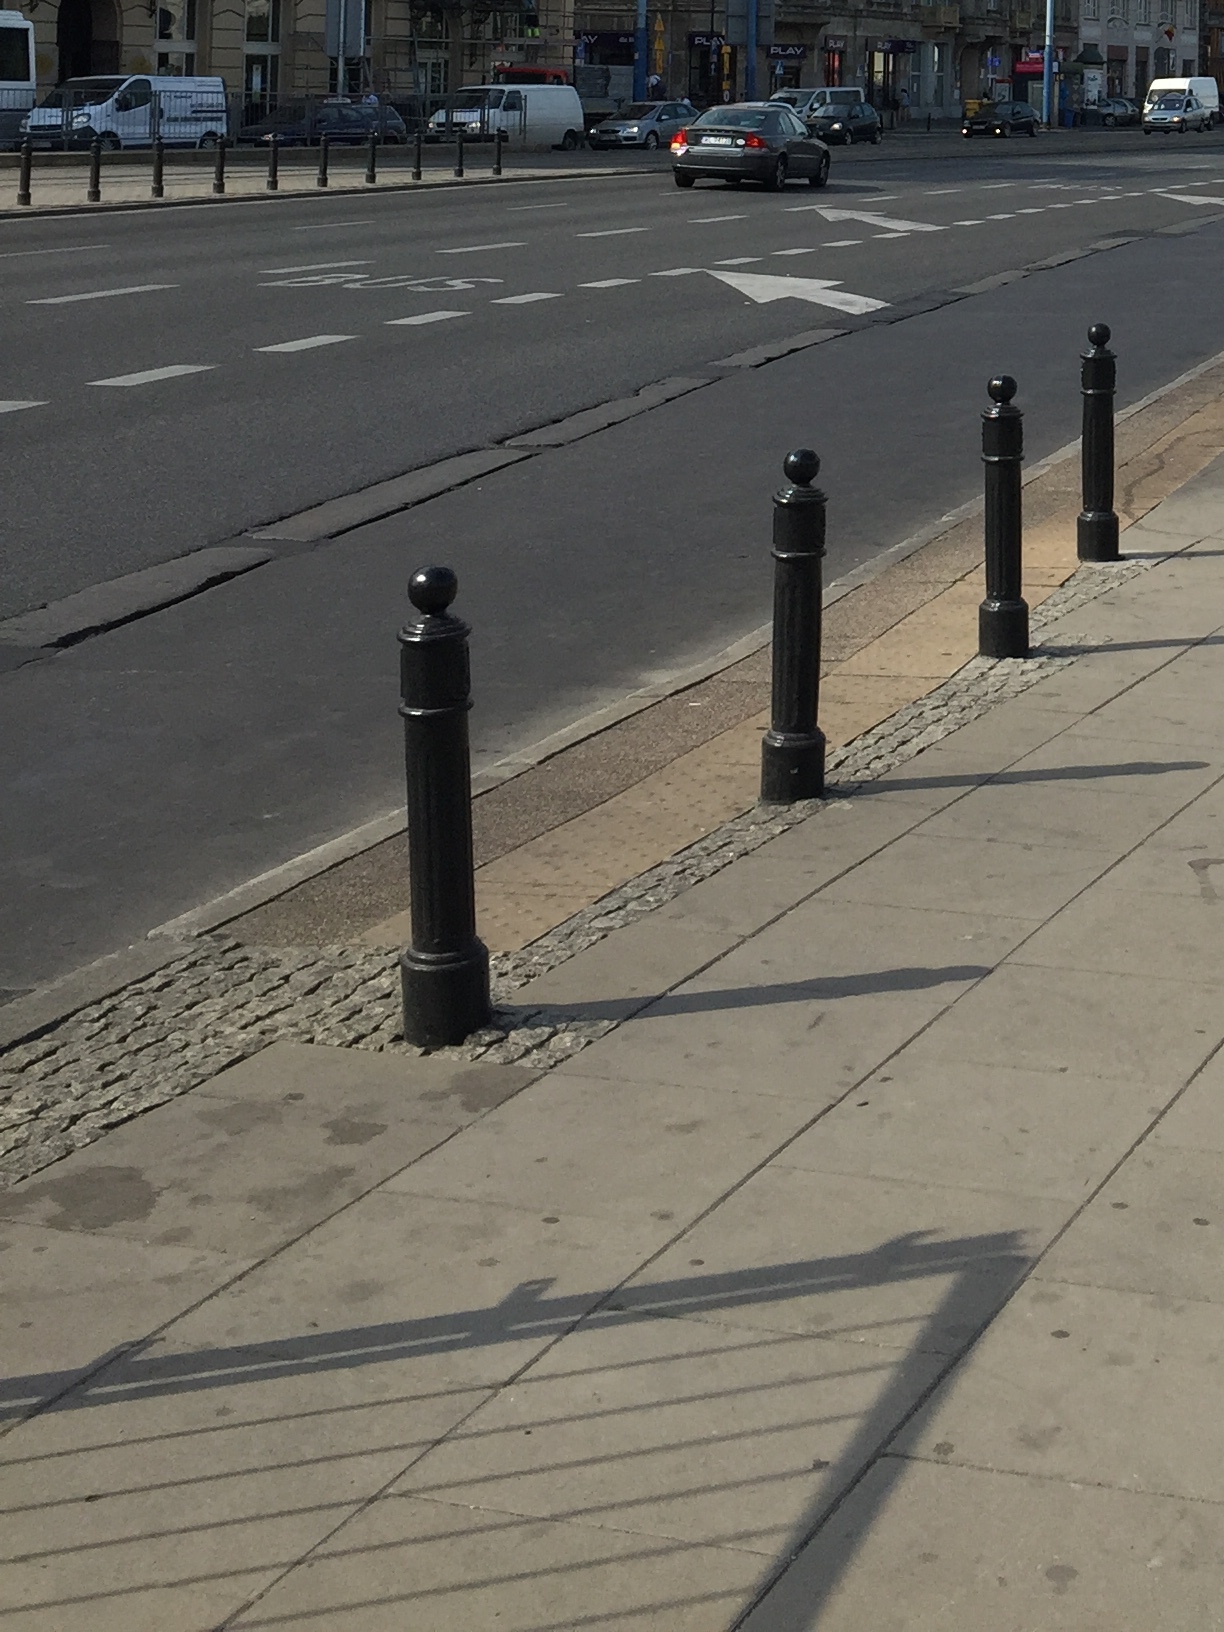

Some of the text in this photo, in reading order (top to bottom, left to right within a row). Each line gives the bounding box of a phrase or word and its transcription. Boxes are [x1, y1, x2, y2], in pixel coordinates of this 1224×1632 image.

[828, 39, 845, 48] PLAY
[770, 46, 804, 55] PLAY
[257, 273, 504, 292] BUS
